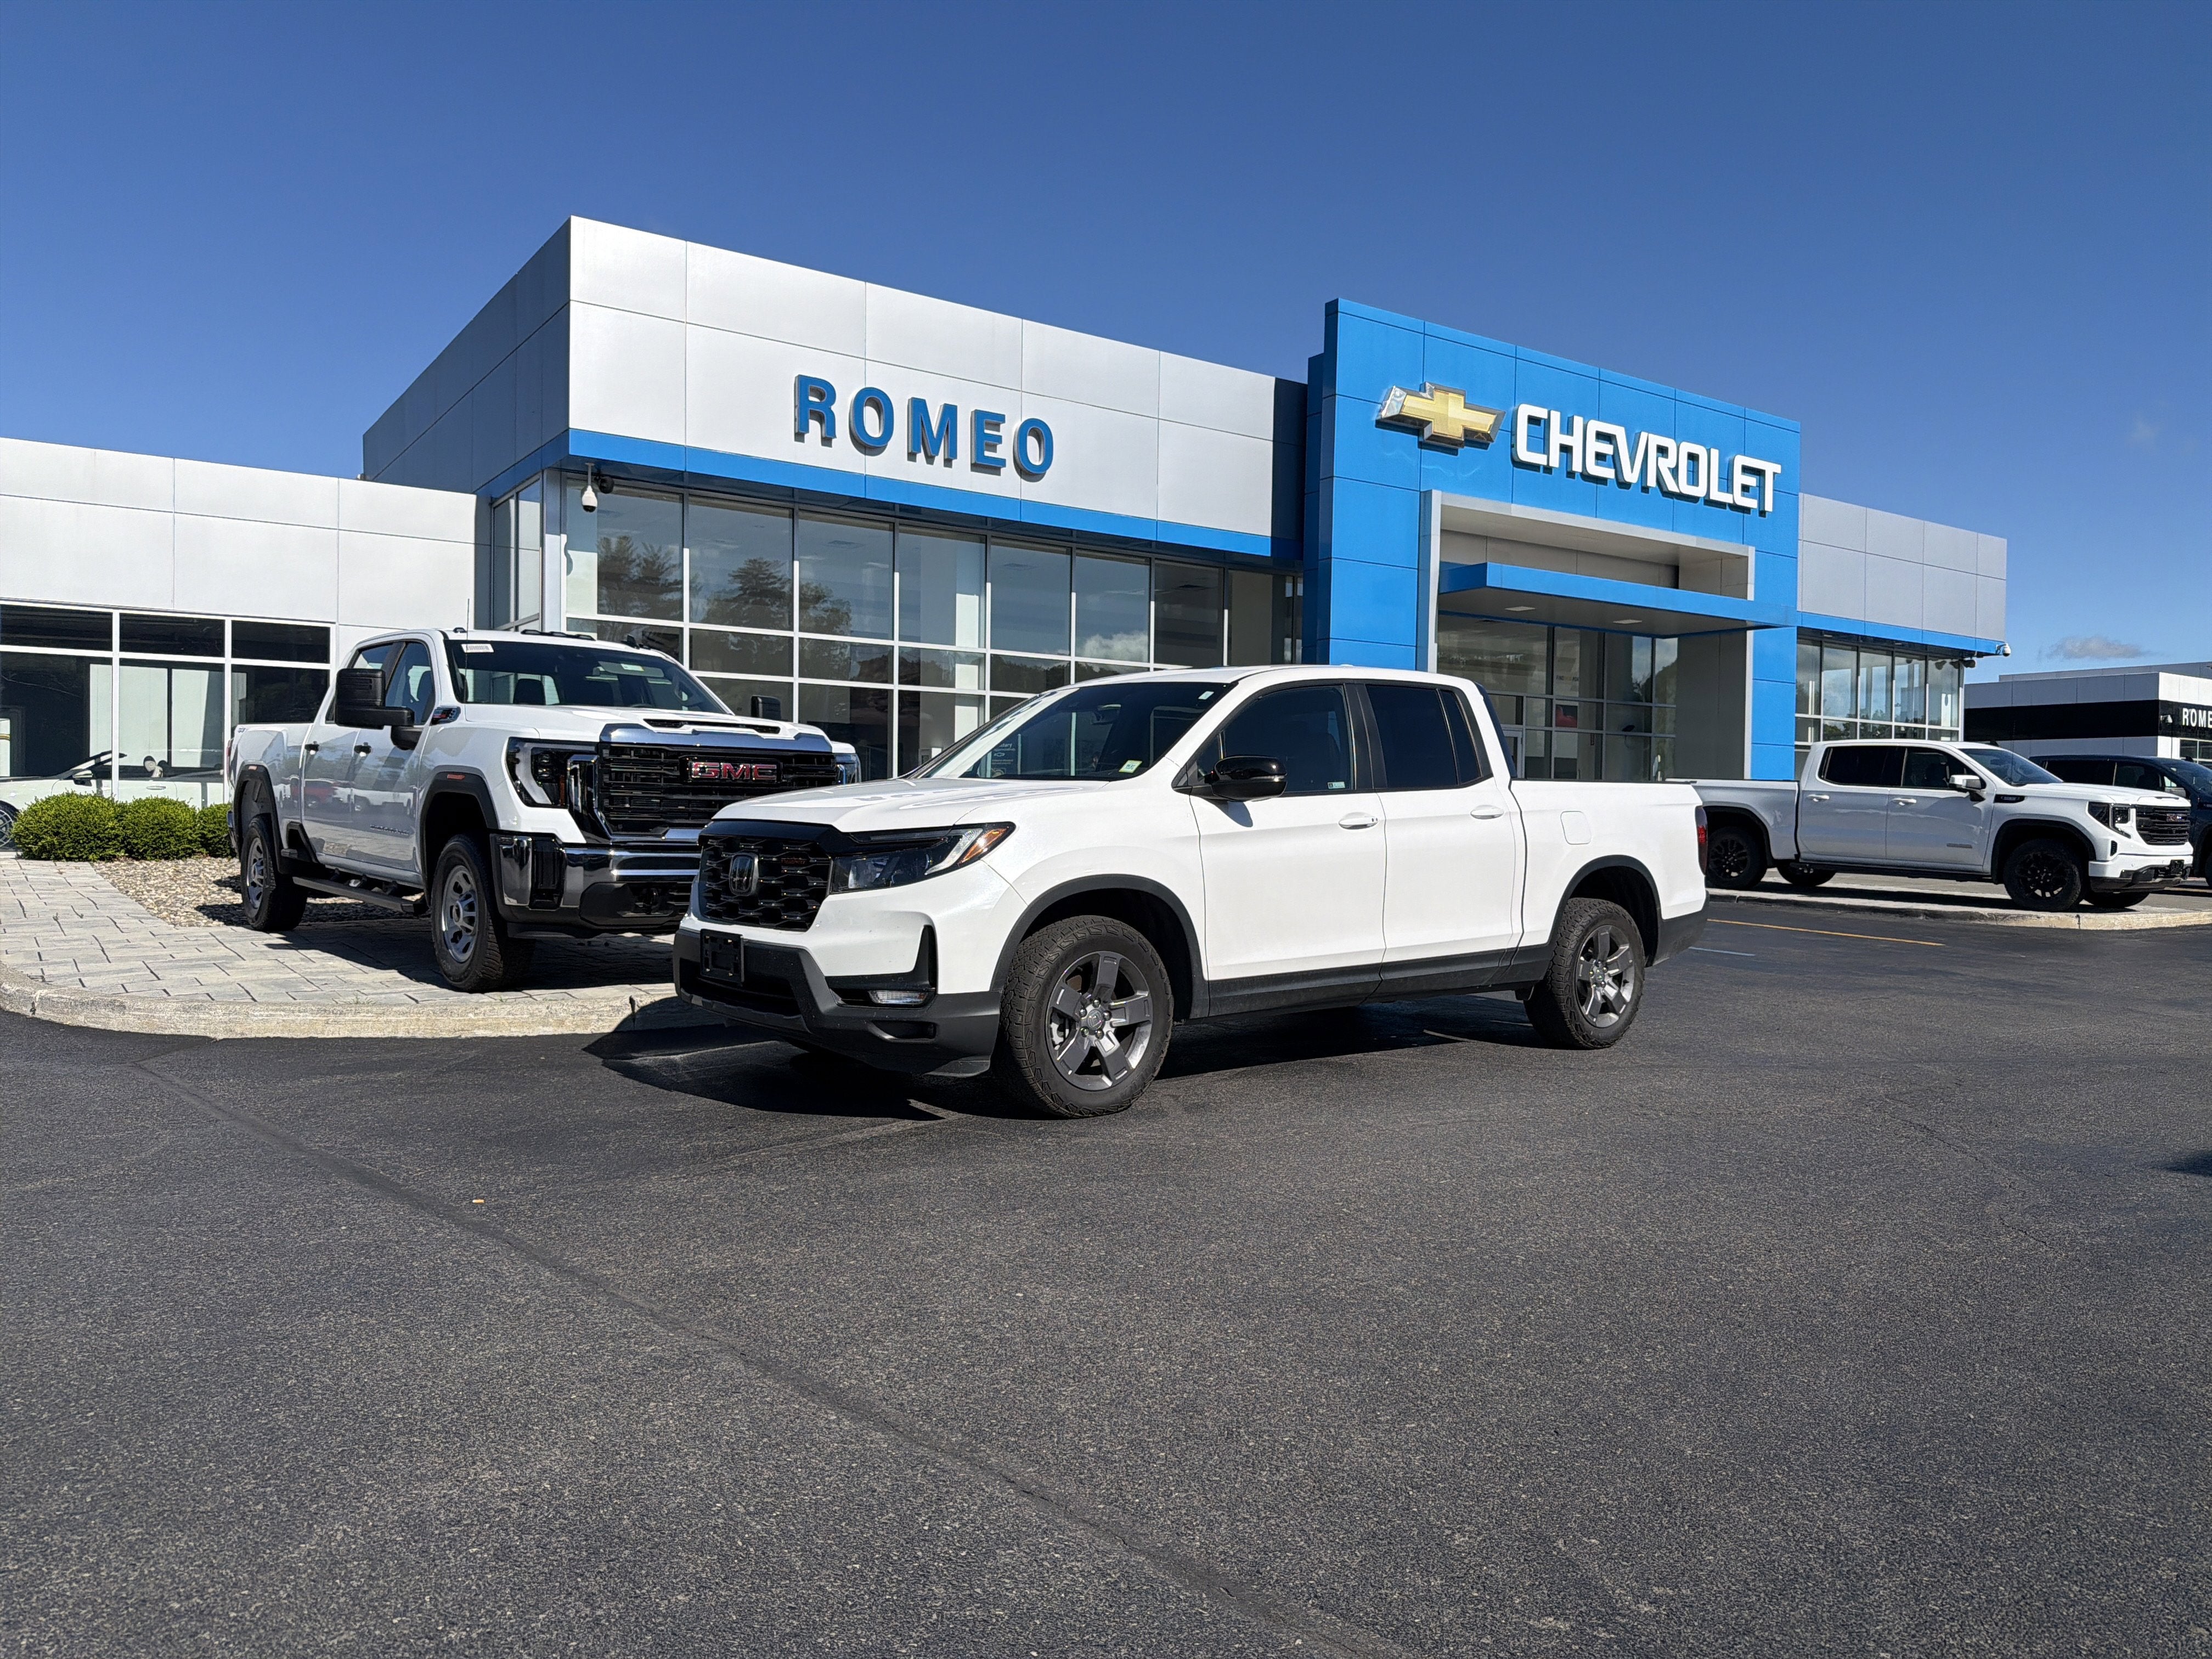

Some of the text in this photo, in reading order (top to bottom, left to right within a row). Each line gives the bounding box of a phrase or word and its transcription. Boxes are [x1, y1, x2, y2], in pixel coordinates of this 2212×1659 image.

[795, 374, 1054, 475] ROMEO
[1514, 403, 1782, 512] CHEVROLET
[2182, 708, 2212, 728] ROME
[692, 762, 777, 780] GMC
